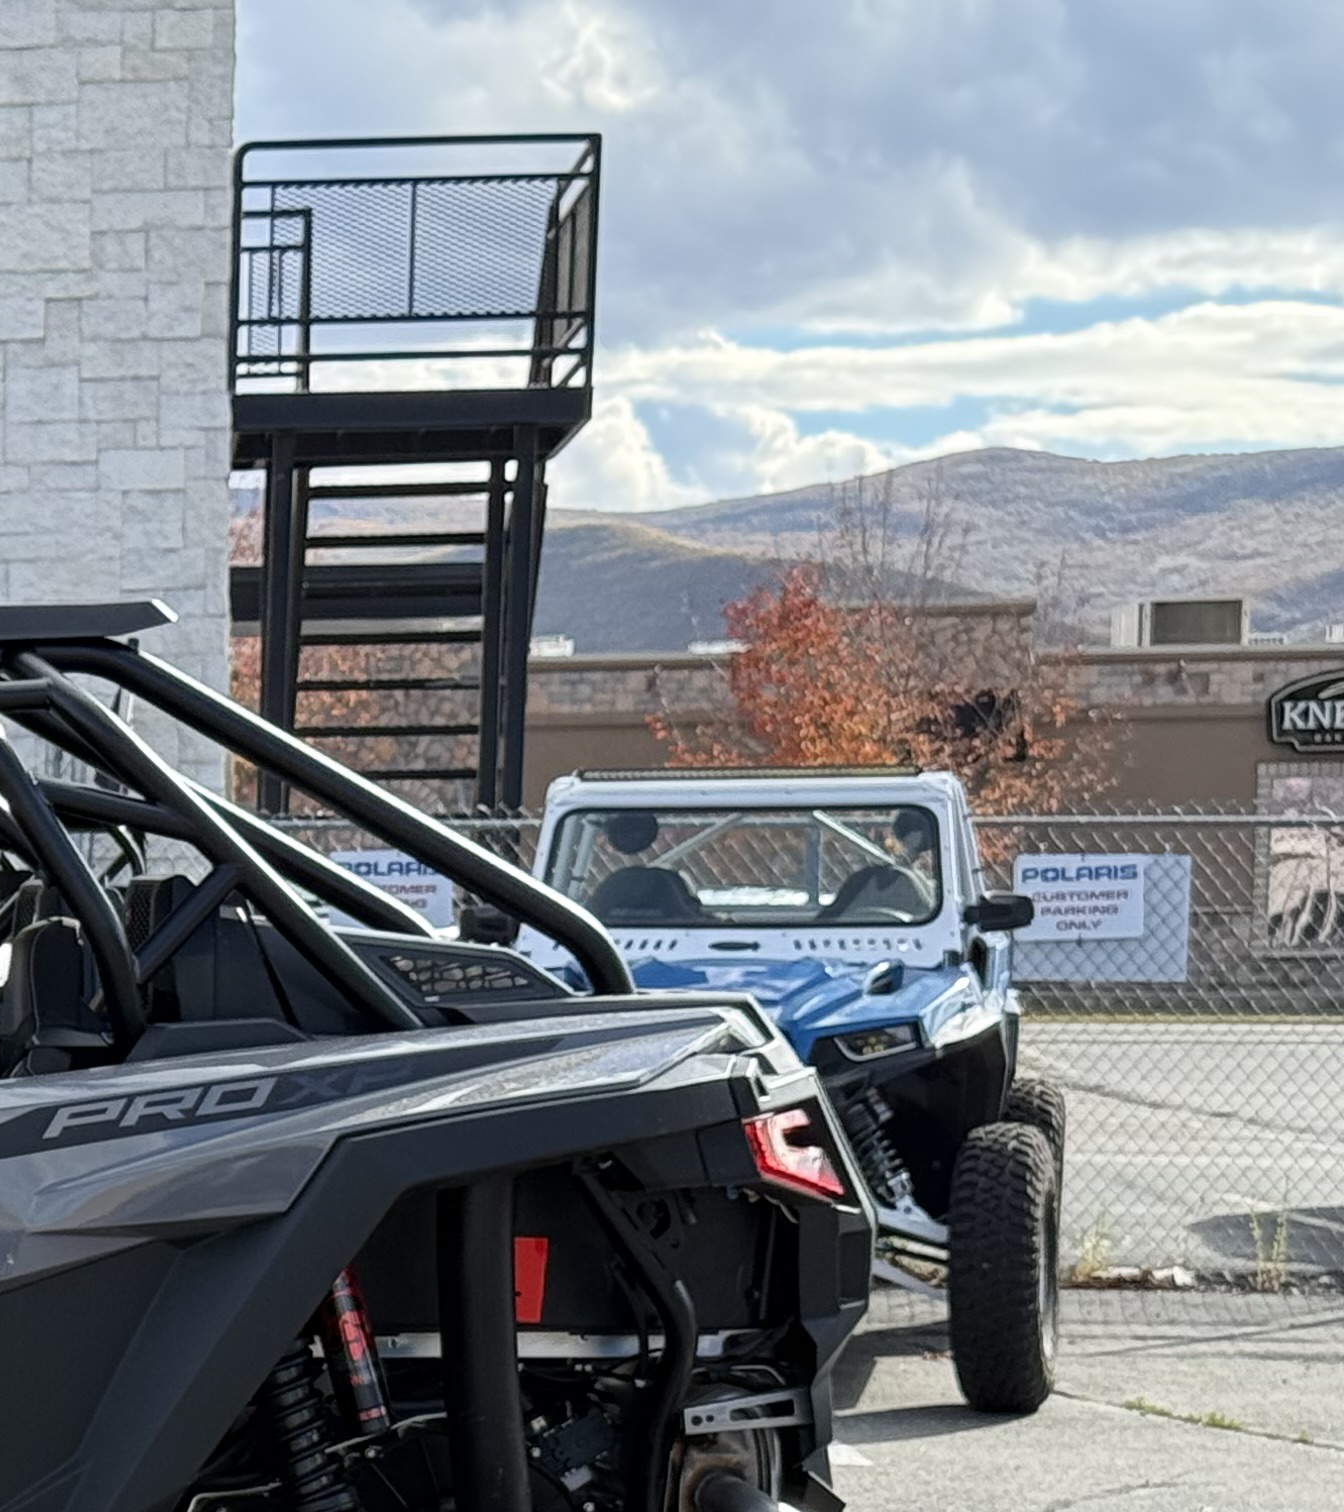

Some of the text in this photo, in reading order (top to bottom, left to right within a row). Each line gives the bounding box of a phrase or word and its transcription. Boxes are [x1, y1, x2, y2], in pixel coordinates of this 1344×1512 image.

[1021, 864, 1138, 884] POLARIS
[1032, 889, 1129, 903] CUSTOMER
[1040, 903, 1120, 917] PARKING
[1055, 919, 1103, 932] ONLY
[42, 1077, 279, 1140] PRO
